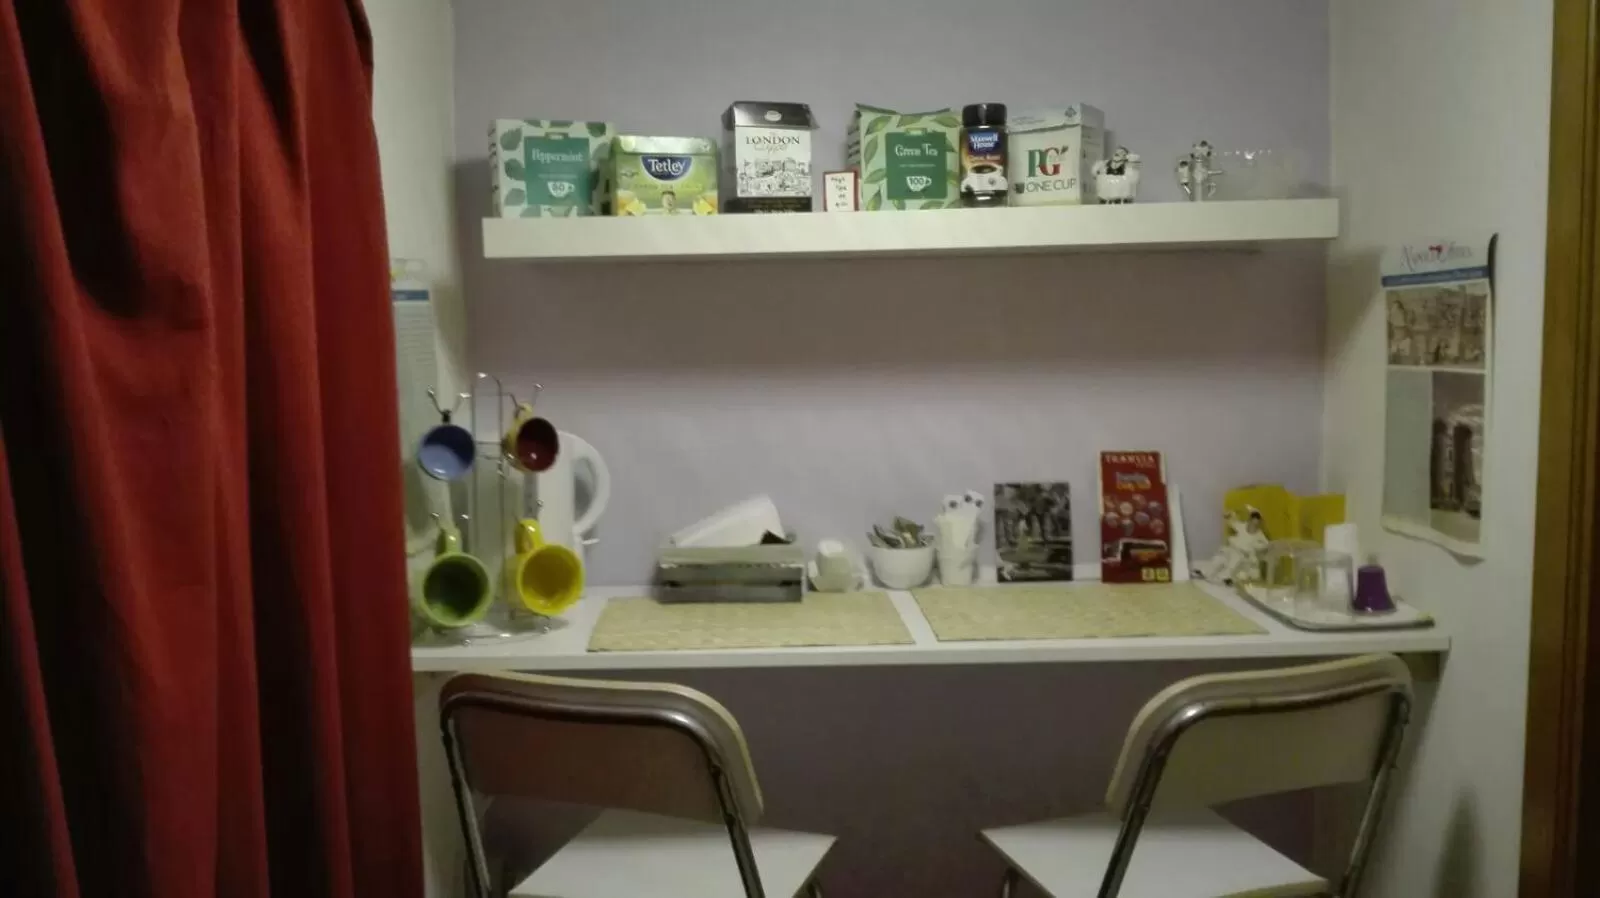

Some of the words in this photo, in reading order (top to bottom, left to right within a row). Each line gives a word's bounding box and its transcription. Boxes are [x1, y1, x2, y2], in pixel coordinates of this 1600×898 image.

[746, 136, 800, 144] LONDON
[970, 132, 998, 142] Maxwell
[895, 144, 921, 157] Green
[922, 144, 938, 156] Tea
[974, 140, 995, 149] House
[531, 148, 584, 164] Peppermint
[1027, 147, 1060, 177] PG
[647, 158, 686, 176] Tetley
[909, 177, 924, 186] 100
[1026, 182, 1052, 193] ONE
[1053, 179, 1076, 190] CUP
